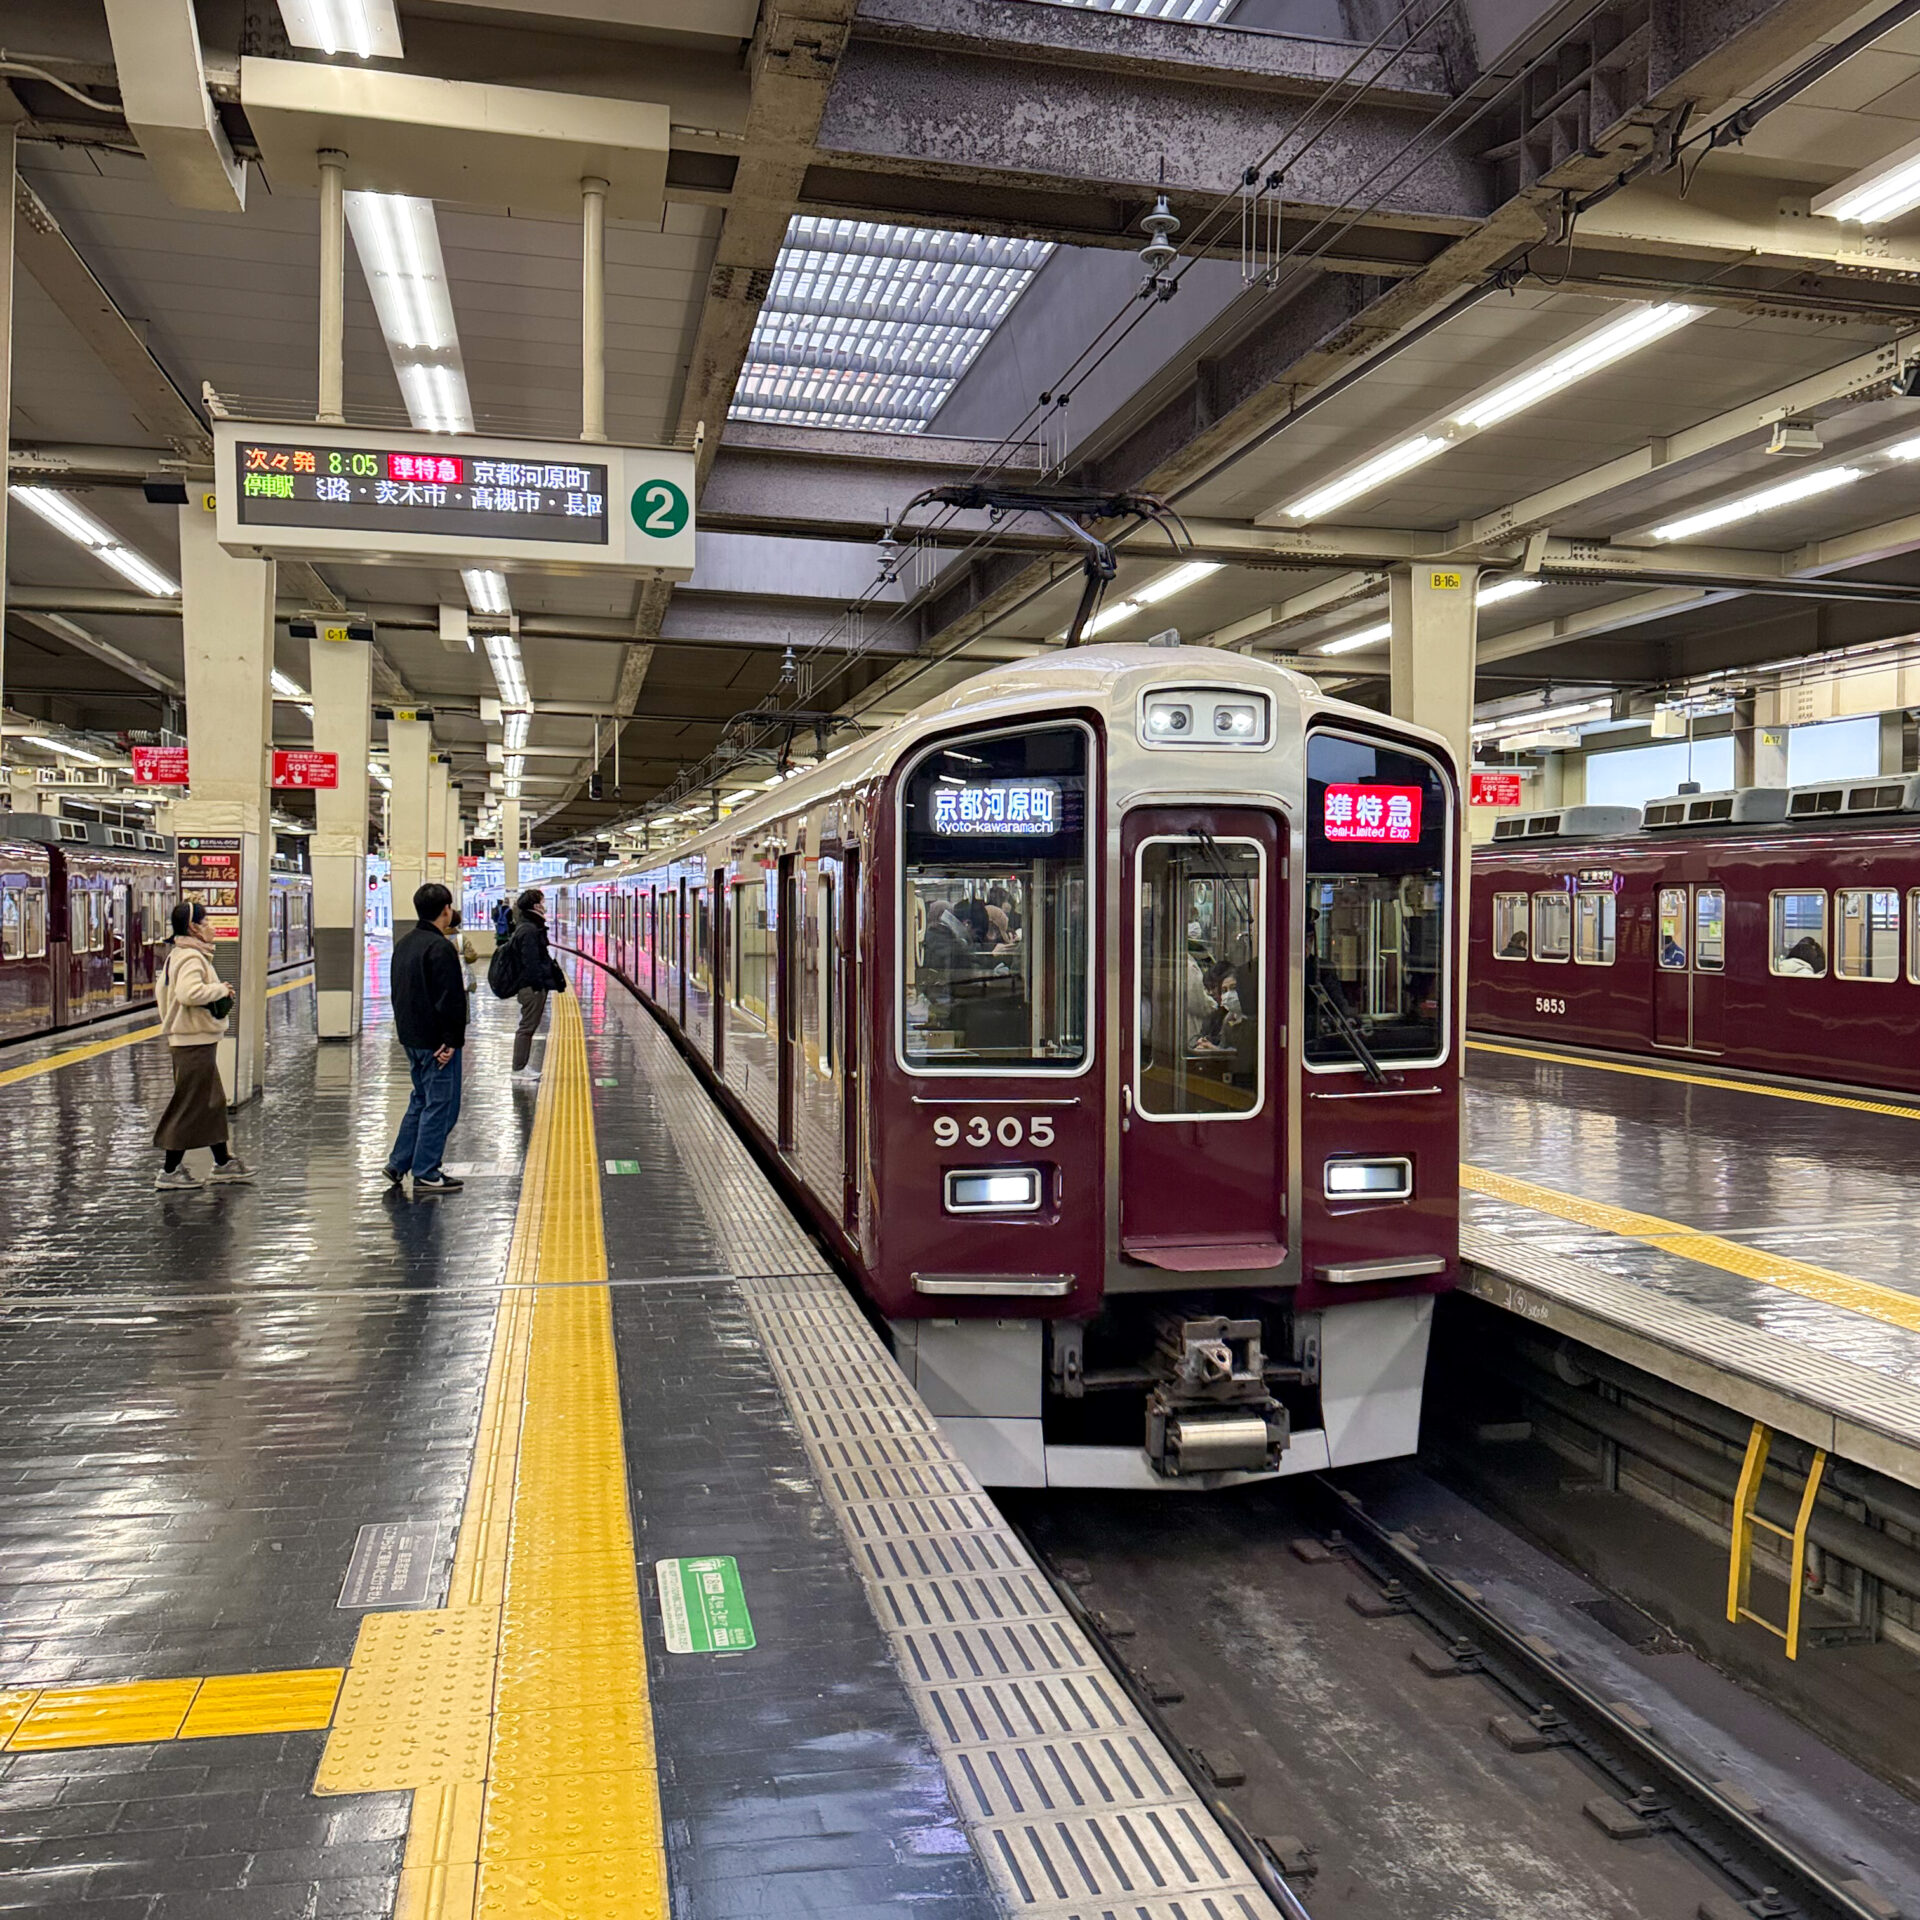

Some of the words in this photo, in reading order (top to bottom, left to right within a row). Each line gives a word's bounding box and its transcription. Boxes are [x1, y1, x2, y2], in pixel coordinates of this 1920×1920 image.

[245, 448, 315, 473] 次々発
[328, 452, 378, 477] 8:05
[394, 457, 457, 481] 準特急
[472, 461, 591, 491] 京都河原町
[243, 472, 295, 499] 停車駅
[645, 486, 676, 530] 2
[137, 759, 158, 768] SOS
[287, 763, 308, 772] SOS
[1482, 784, 1497, 792] SOS
[934, 787, 1055, 821] 京都河原町
[1325, 793, 1412, 828] 準特急
[936, 821, 1054, 835] Kyoto-kawaramachi
[1325, 825, 1386, 838] Semi-Limited
[1389, 827, 1412, 840] Exp.
[1535, 997, 1566, 1015] 5853
[933, 1116, 1055, 1147] 9305
